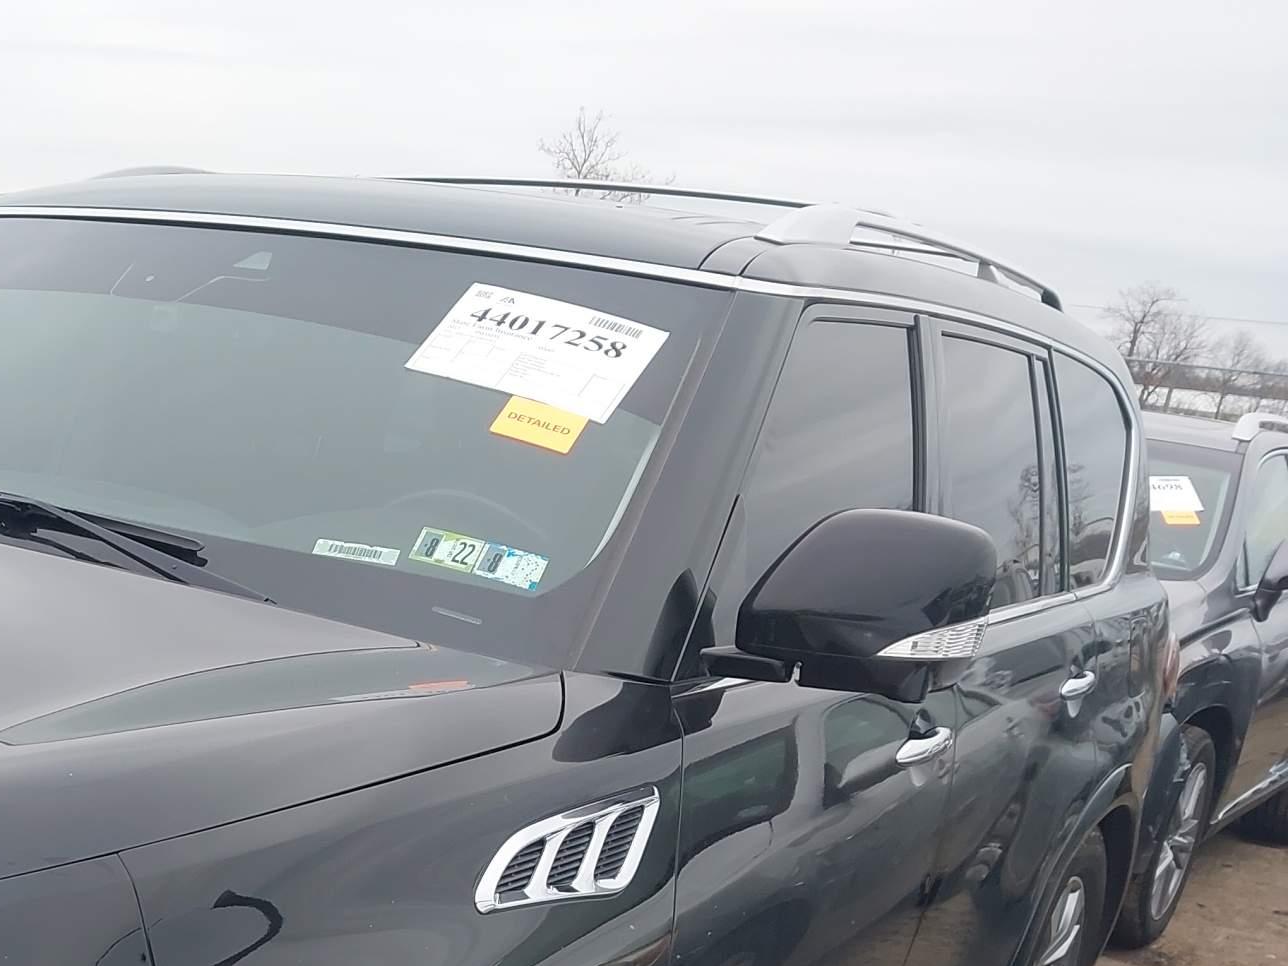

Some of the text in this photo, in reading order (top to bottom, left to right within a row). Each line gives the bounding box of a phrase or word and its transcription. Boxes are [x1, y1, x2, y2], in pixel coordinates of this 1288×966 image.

[469, 307, 628, 359] 44017258
[507, 411, 571, 435] DETAILED
[451, 541, 476, 566] 22
